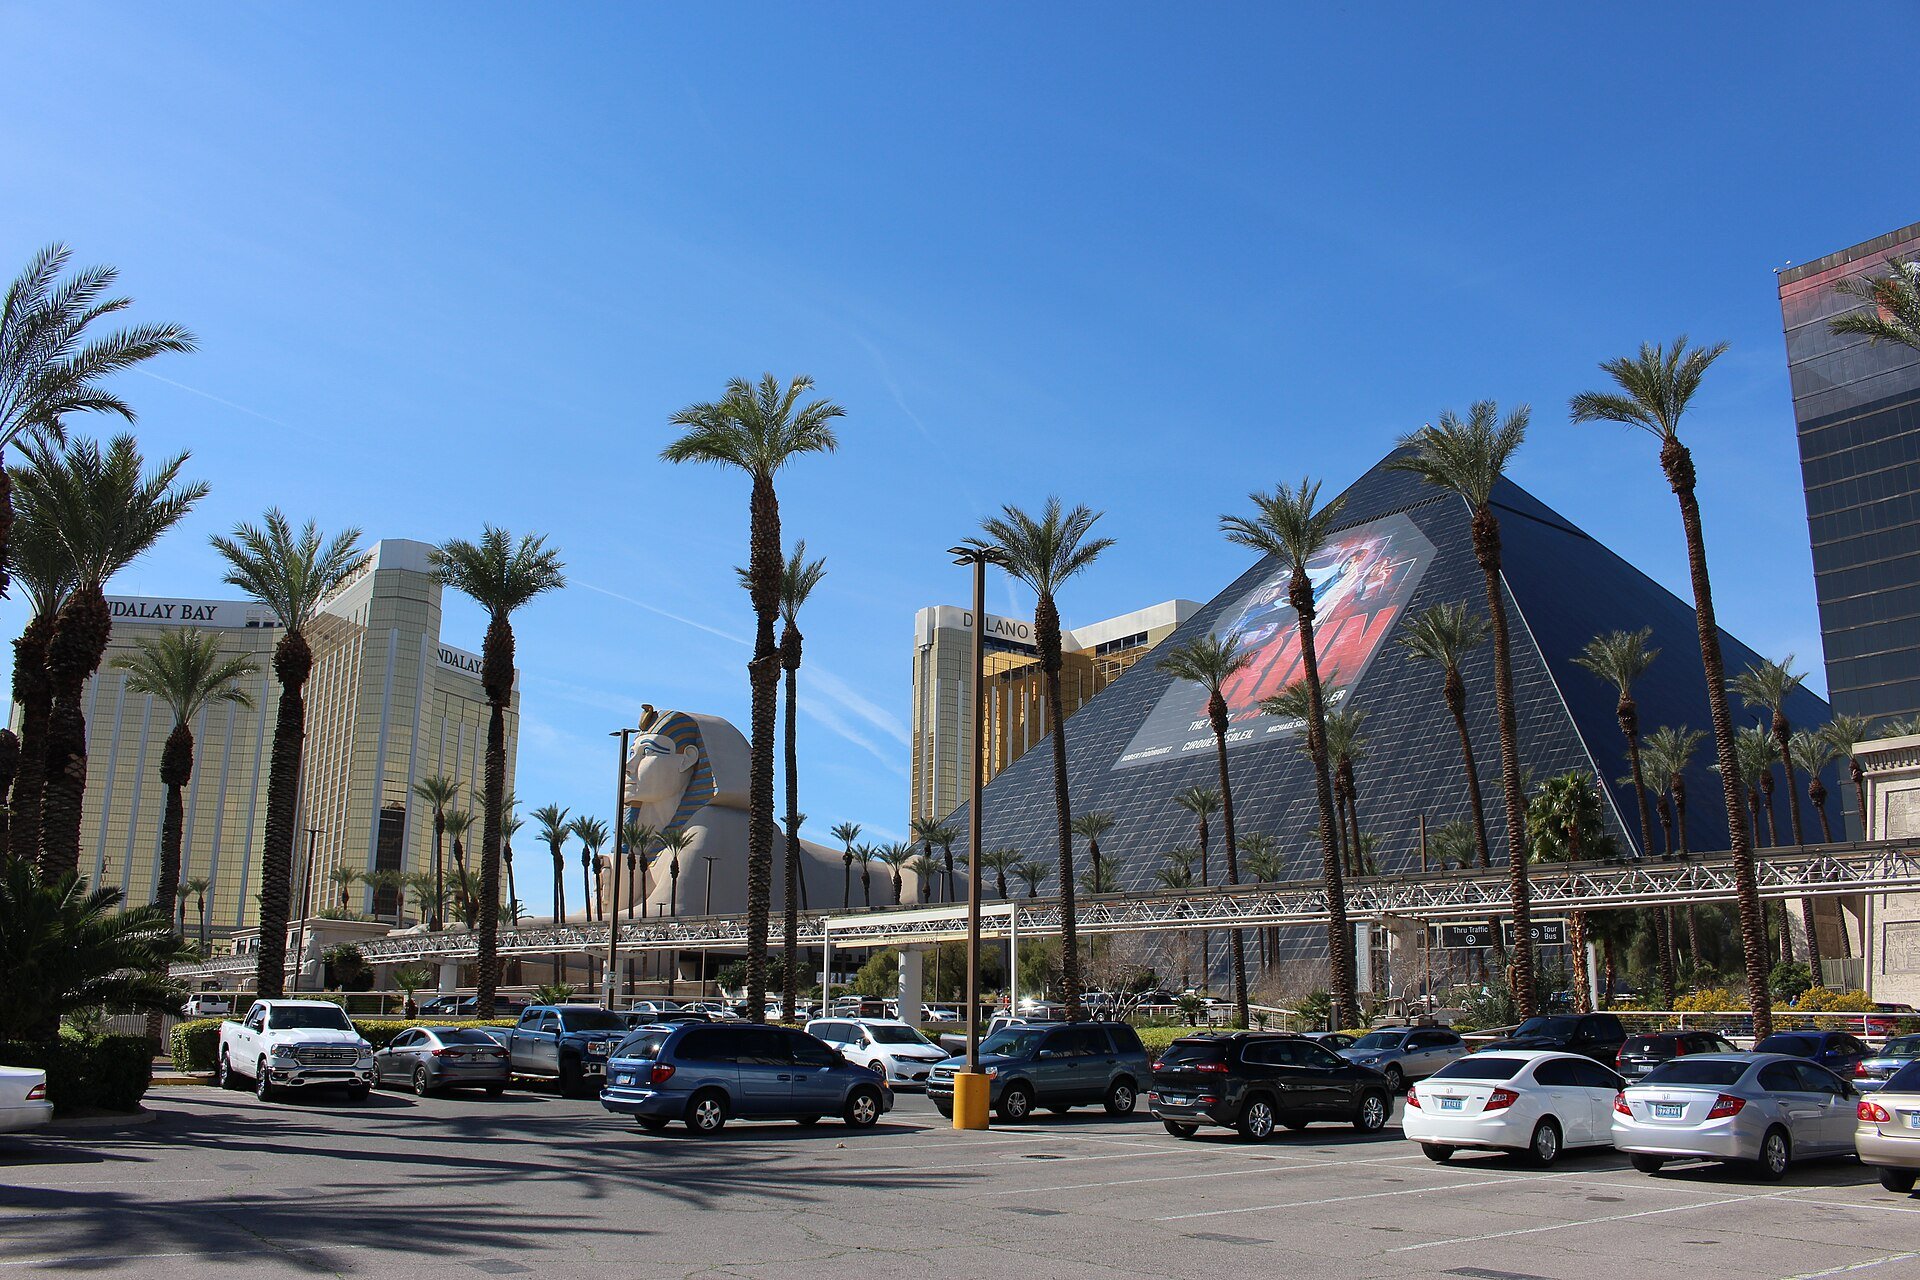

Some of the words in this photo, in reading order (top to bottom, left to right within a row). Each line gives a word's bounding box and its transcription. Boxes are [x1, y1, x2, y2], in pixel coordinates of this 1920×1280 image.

[180, 604, 218, 621] BAY
[963, 613, 1029, 639] DLANO
[437, 648, 482, 674] NDALAY
[1188, 719, 1207, 732] THE
[1266, 722, 1295, 734] MICHAEL
[1182, 737, 1213, 751] CIRQUE
[1225, 729, 1255, 743] SOLEIL
[1453, 926, 1468, 934] Thru
[1469, 926, 1489, 934] Traffic
[1543, 925, 1558, 933] Tour
[1544, 932, 1557, 940] Bus
